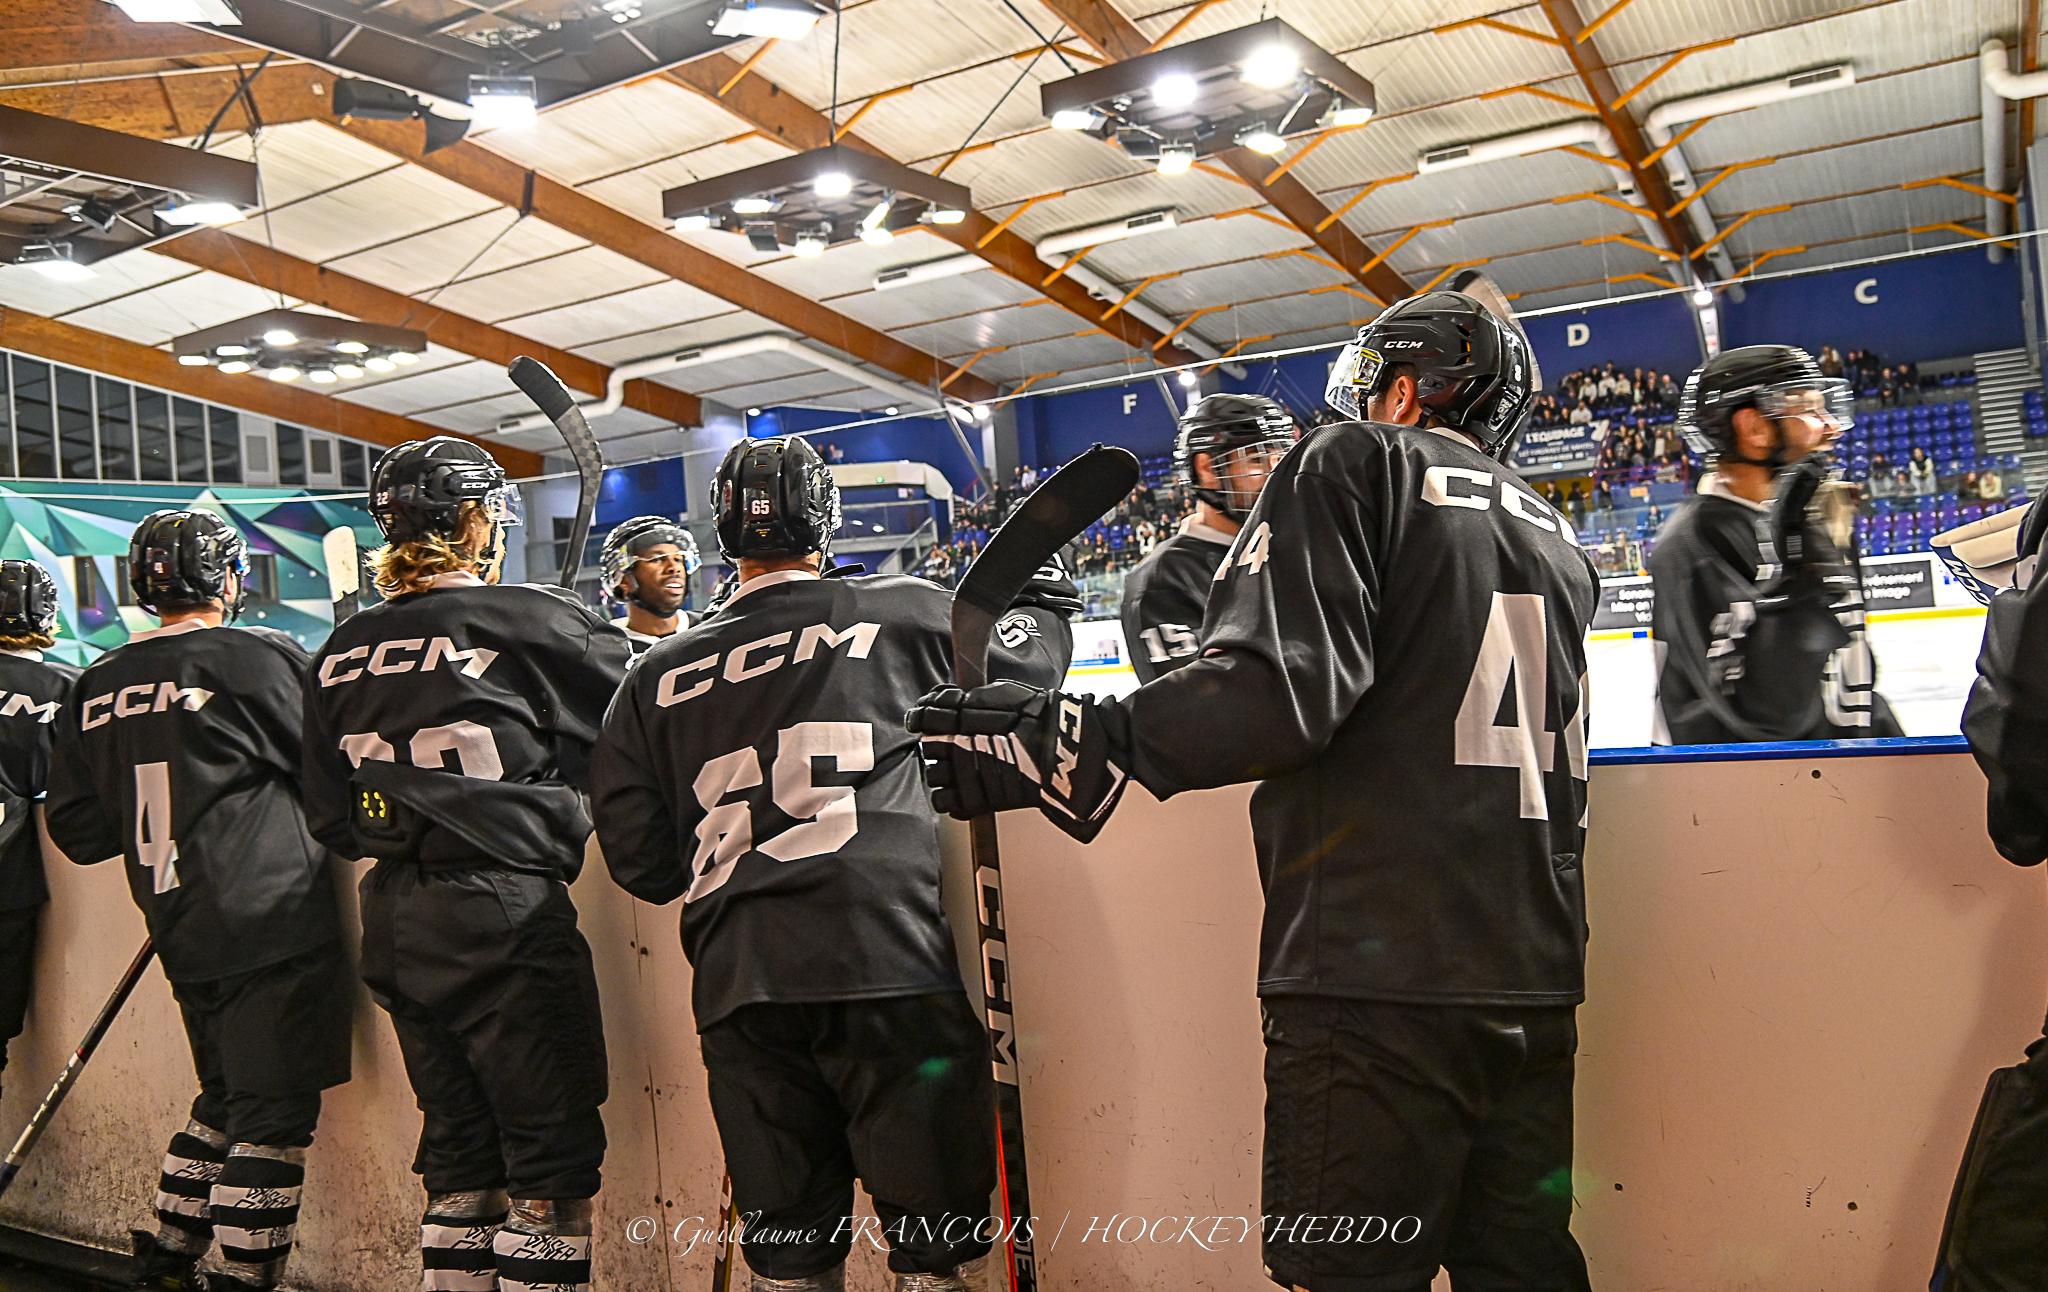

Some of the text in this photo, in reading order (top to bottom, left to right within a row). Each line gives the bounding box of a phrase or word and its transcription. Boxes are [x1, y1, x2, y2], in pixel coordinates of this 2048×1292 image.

[1854, 278, 1879, 304] C
[1384, 340, 1424, 349] CCM
[1567, 323, 1590, 347] D
[1123, 393, 1138, 415] F
[461, 481, 490, 489] CCM
[751, 500, 770, 515] 65
[154, 562, 164, 574] 4
[1140, 623, 1199, 663] 15
[318, 636, 500, 688] CCM
[656, 621, 882, 708] CCM
[82, 681, 215, 732] CCM
[135, 761, 181, 895] 4
[685, 721, 875, 904] 65
[975, 865, 1020, 1087] CCM
